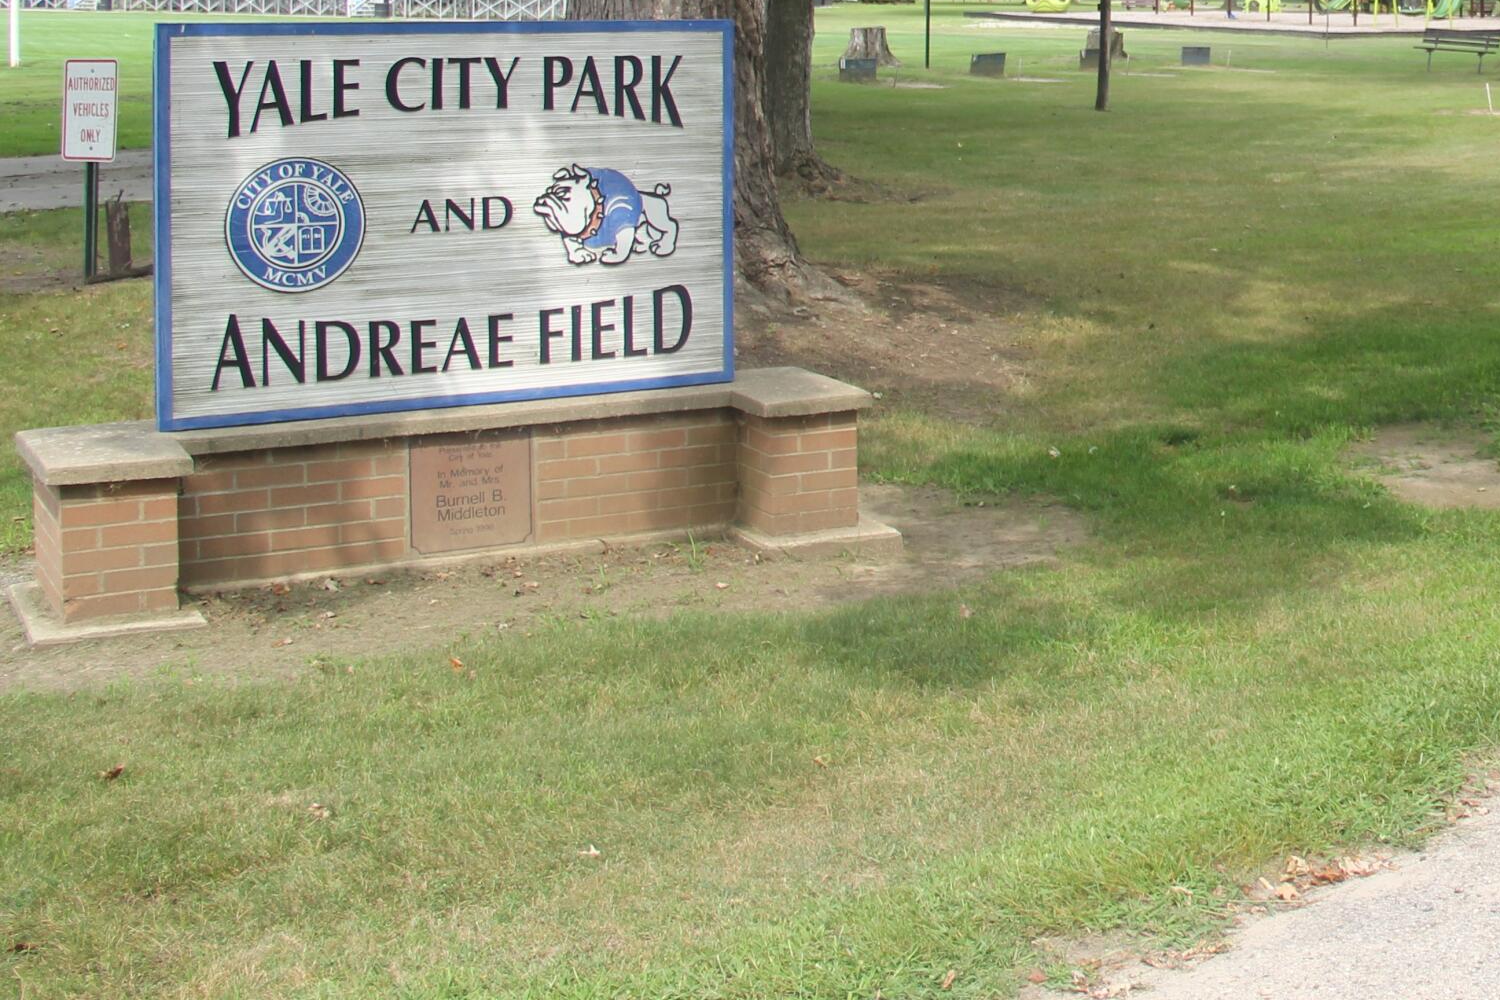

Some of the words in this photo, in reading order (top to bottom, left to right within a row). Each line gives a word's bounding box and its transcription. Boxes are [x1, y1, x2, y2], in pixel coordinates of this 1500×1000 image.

[68, 77, 115, 92] AUTHORIZED
[212, 58, 360, 139] YALE
[384, 55, 521, 113] CITY
[543, 54, 684, 129] PARK
[73, 103, 109, 118] VEHICLES
[80, 129, 101, 143] ONLY
[236, 169, 275, 210] CITY
[278, 163, 306, 178] OF
[311, 164, 355, 205] YALE
[411, 195, 514, 234] AND
[263, 265, 328, 286] MCMV
[211, 312, 515, 392] ANDREAE
[539, 283, 694, 366] FIELD
[436, 491, 485, 509] Burnell
[437, 504, 506, 522] Middleton
